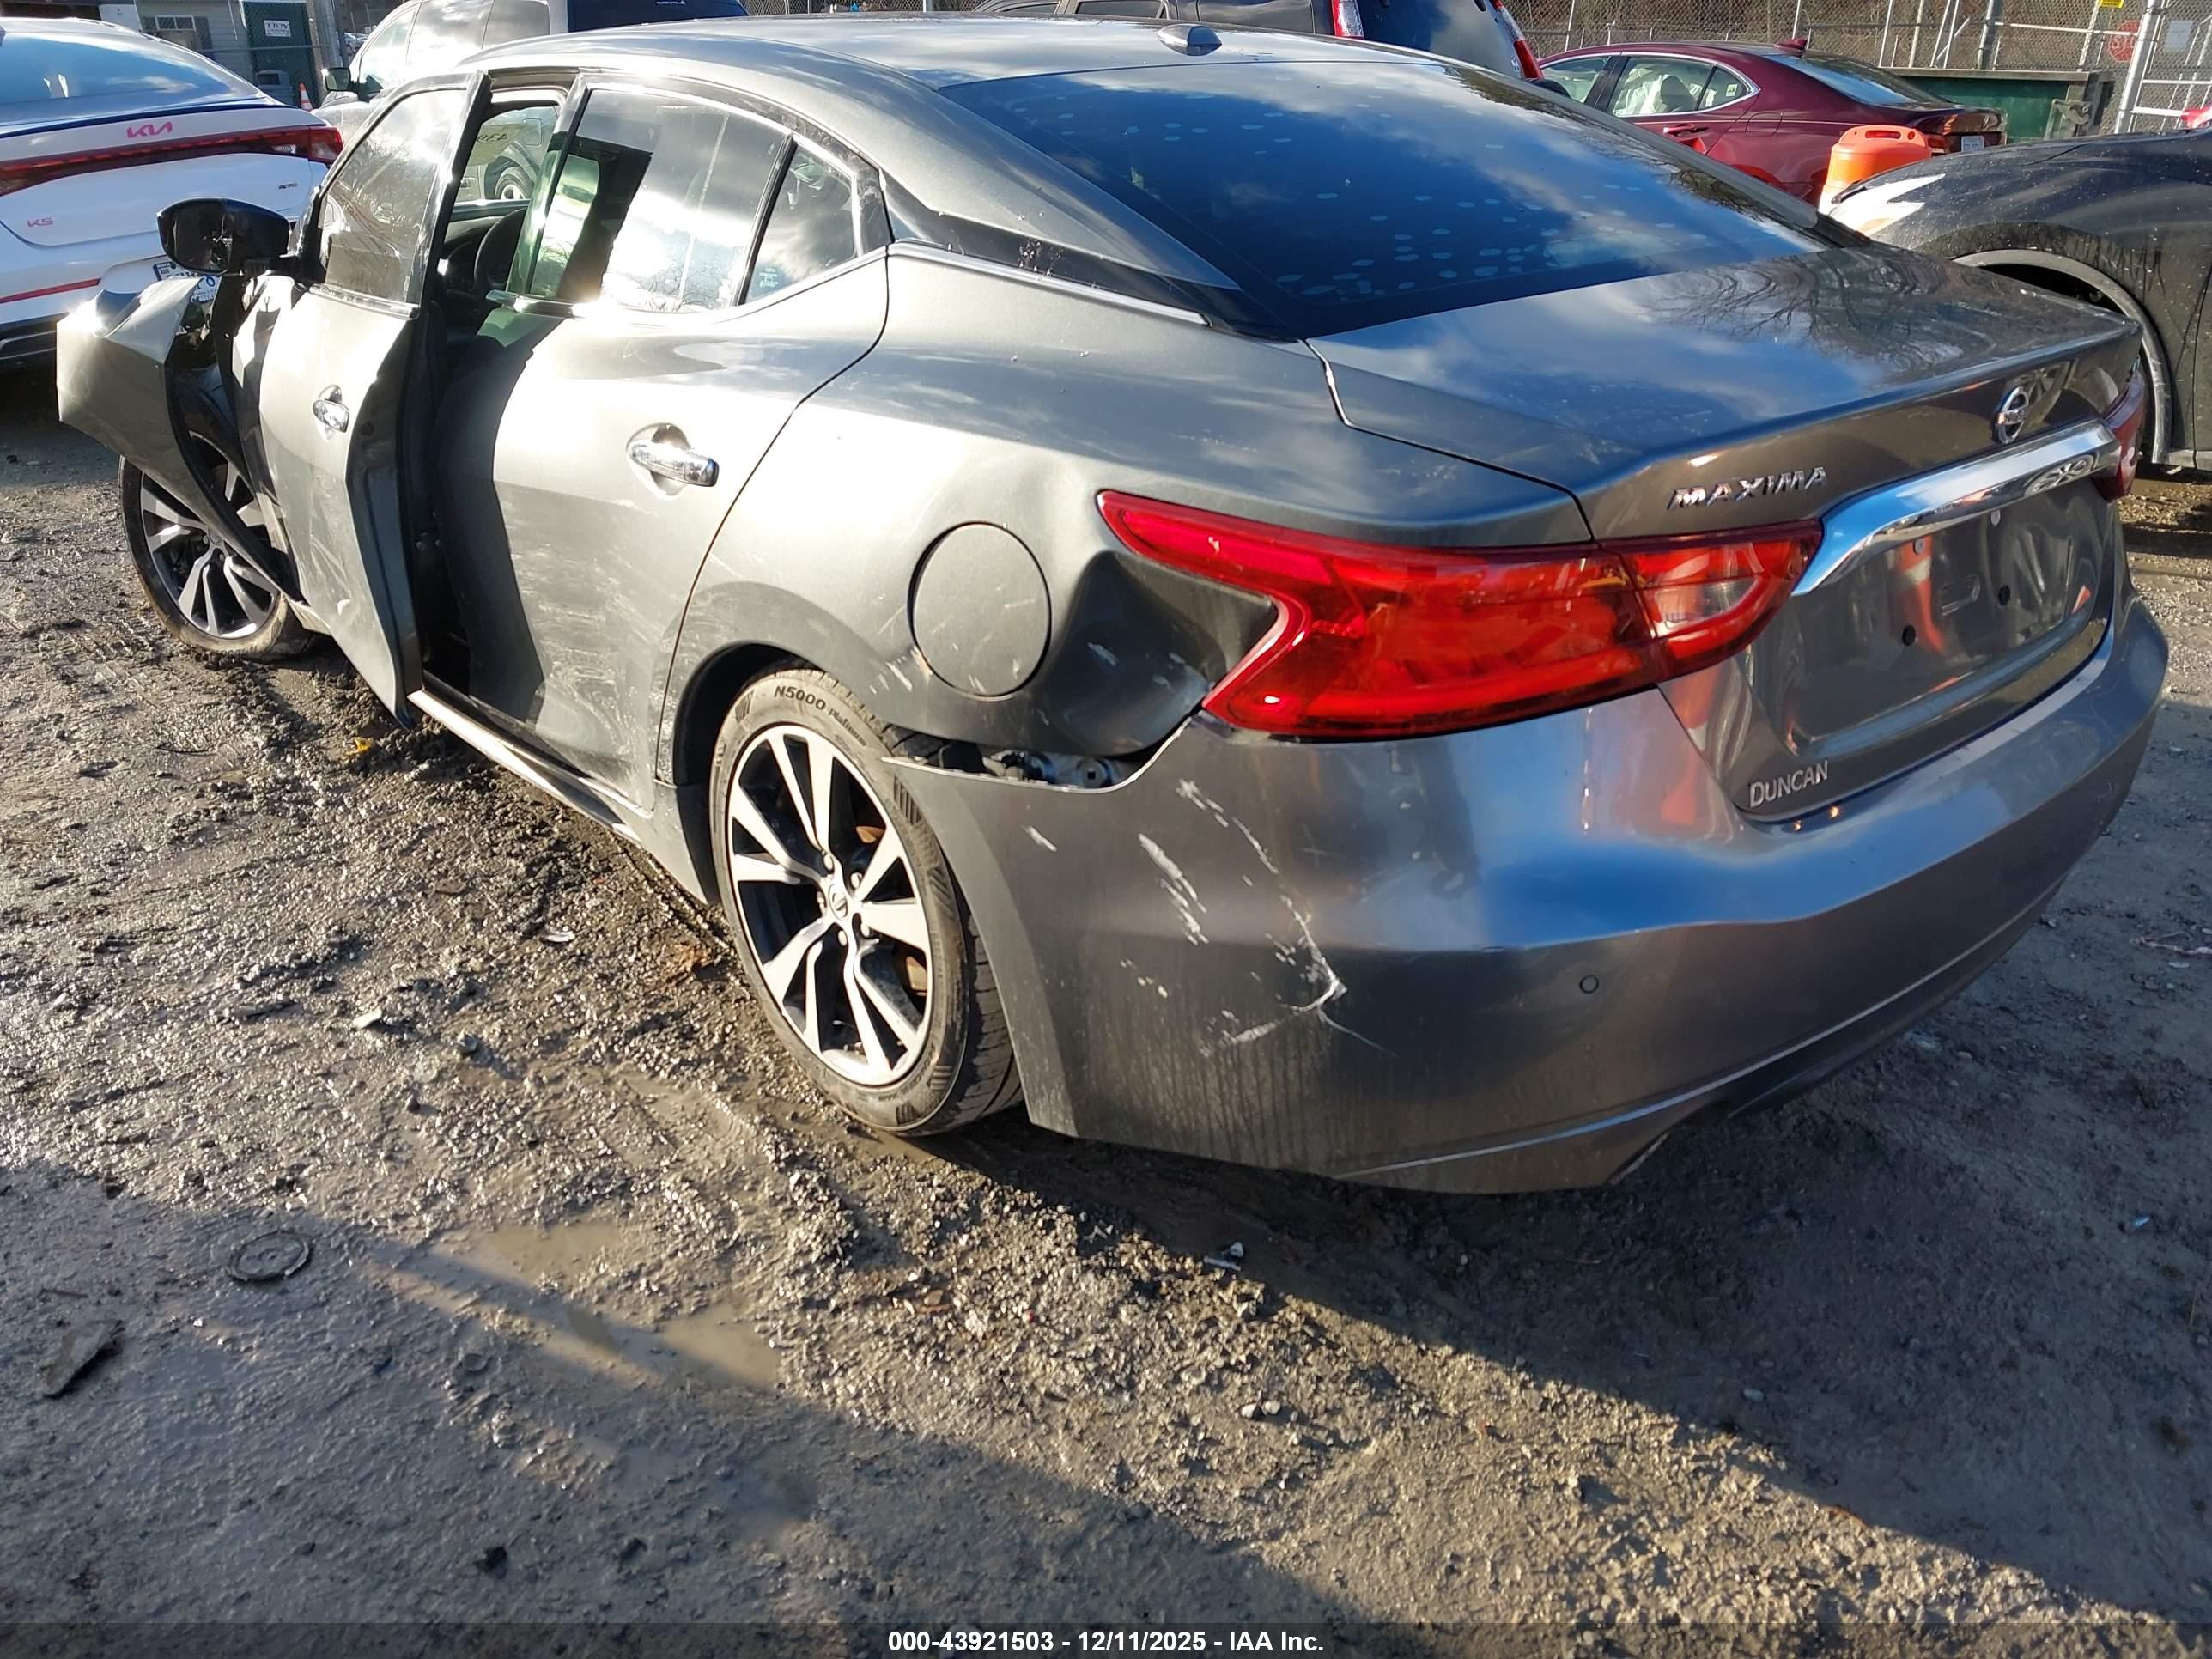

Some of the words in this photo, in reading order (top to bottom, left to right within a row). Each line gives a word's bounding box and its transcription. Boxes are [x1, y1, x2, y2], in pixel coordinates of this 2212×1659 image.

[1667, 467, 1828, 510] MAXIMA
[774, 685, 826, 710] N5000
[1749, 760, 1828, 808] DUNCAN
